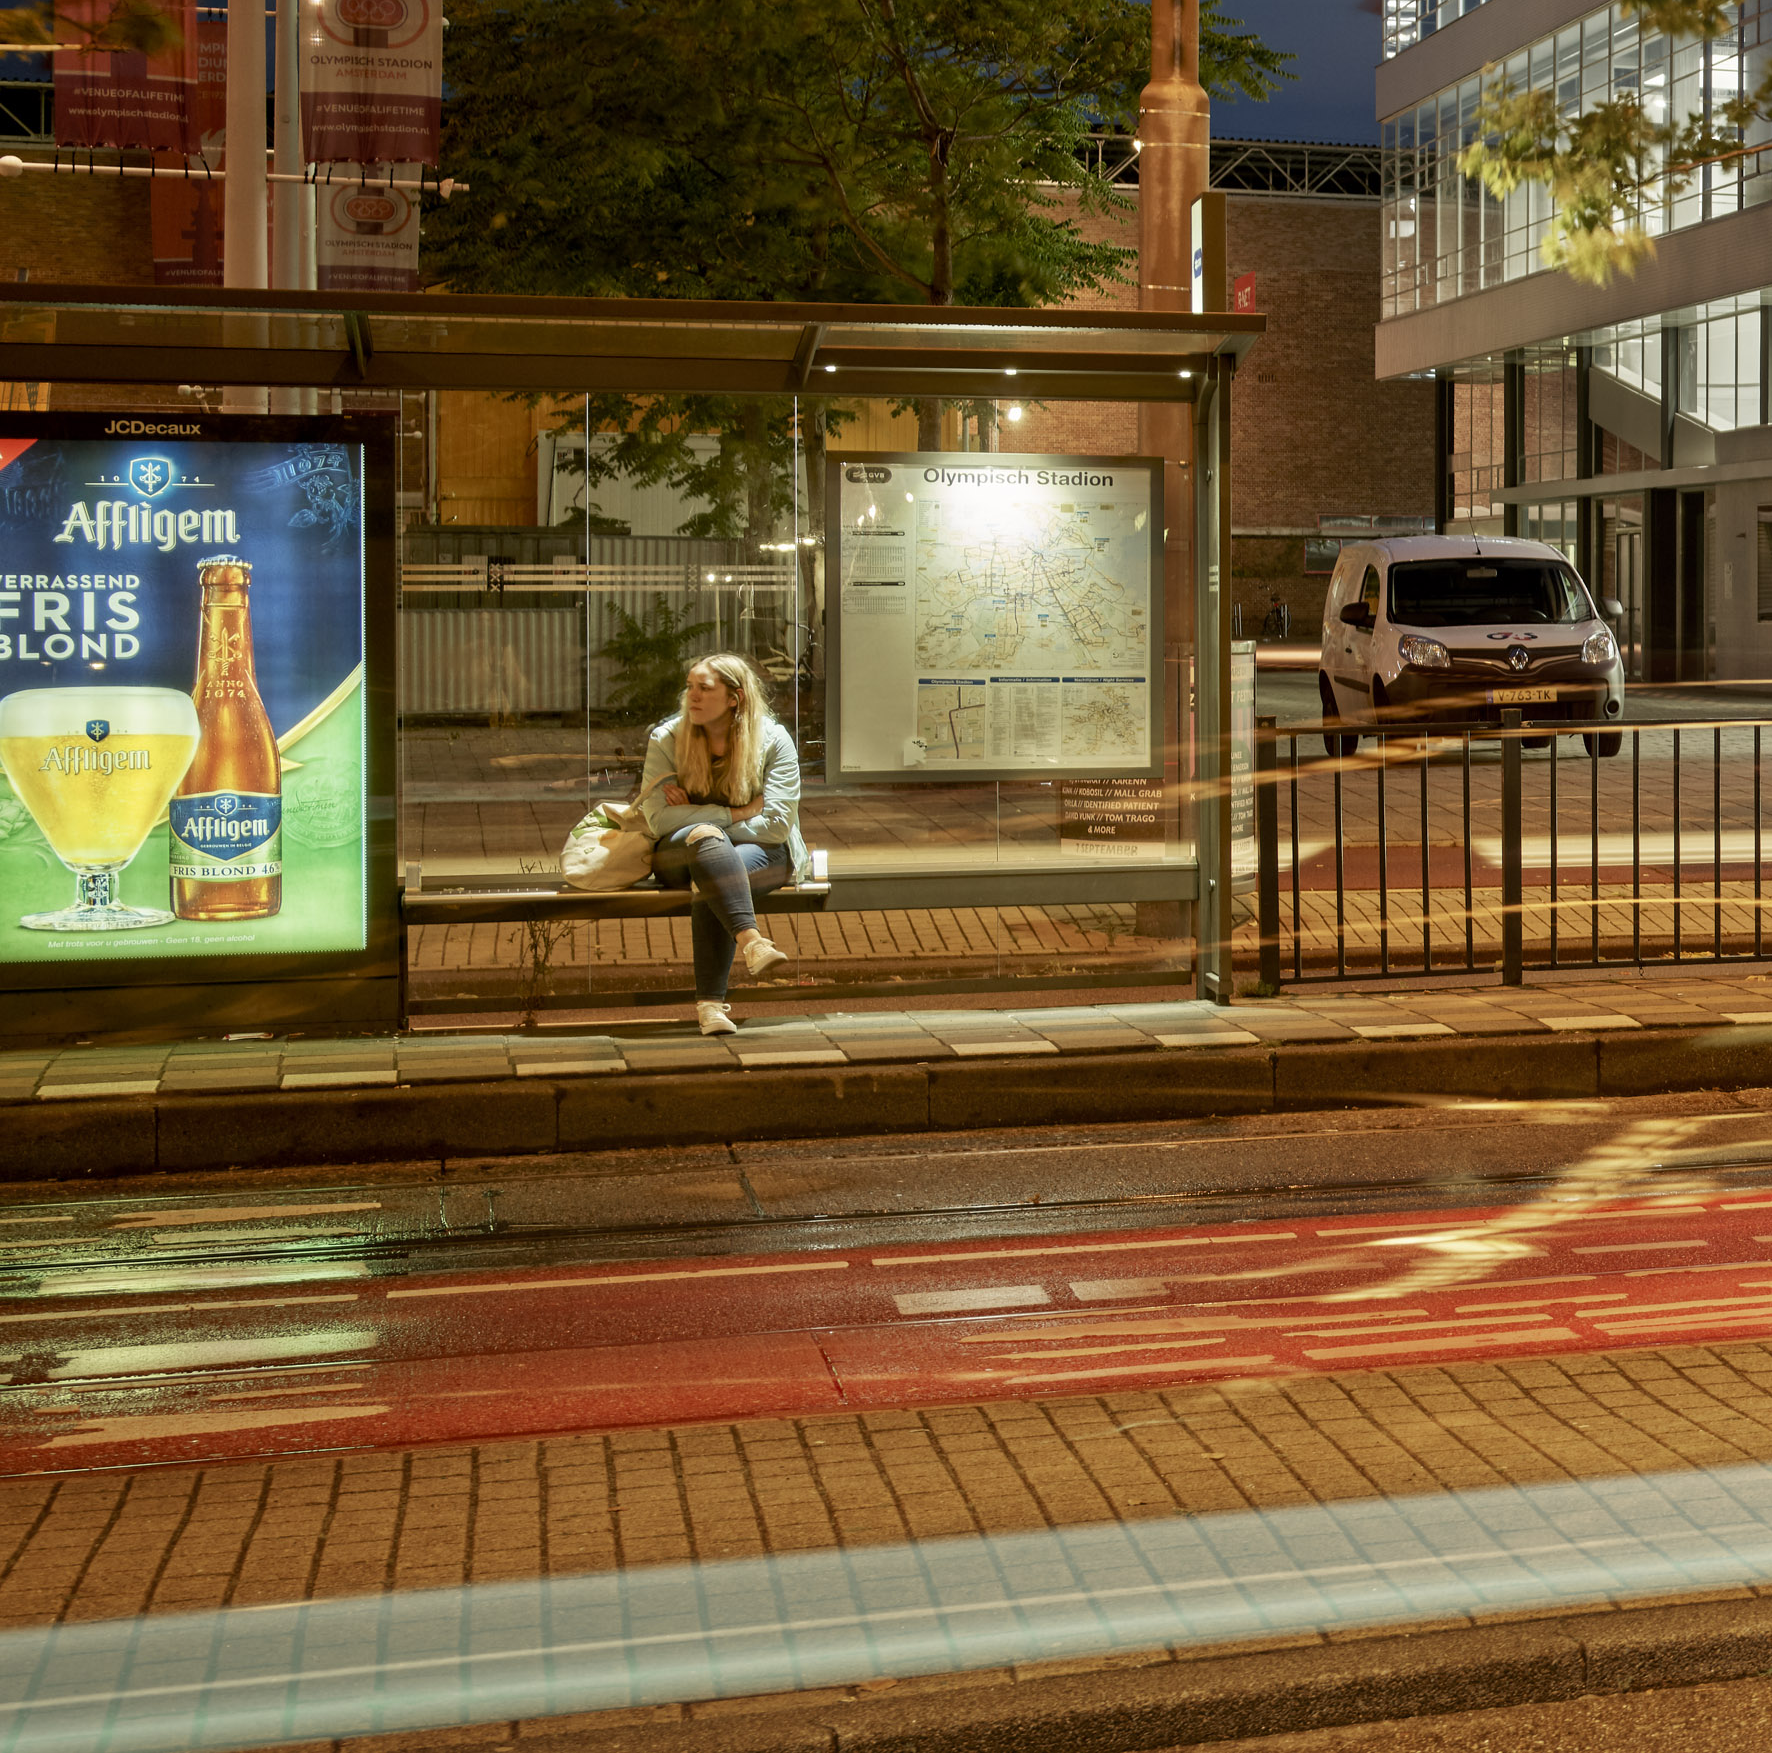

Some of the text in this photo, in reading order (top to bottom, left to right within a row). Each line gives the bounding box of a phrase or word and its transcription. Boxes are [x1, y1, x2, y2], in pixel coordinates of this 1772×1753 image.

[310, 55, 433, 69] OLYMPISCH STADION
[336, 68, 407, 80] AMSTERDAM
[105, 420, 201, 435] JCDecaux
[923, 468, 1114, 487] Olympisch Stadion
[54, 501, 241, 551] Affligem
[0, 574, 140, 590] ERRASSEND
[0, 591, 140, 632] FRIS
[0, 633, 140, 660] BLOND
[206, 680, 244, 689] ANNO
[205, 689, 247, 699] 1074
[1498, 690, 1551, 702] V-763-TK
[38, 746, 151, 776] Affligem
[1079, 787, 1103, 796] KOBOSIL
[1114, 789, 1136, 798] MALL
[1138, 790, 1162, 798] GRAB
[1083, 801, 1121, 809] IDENTIFIED
[1123, 802, 1159, 810] PATIENT
[1105, 814, 1123, 822] TOM
[1126, 814, 1155, 823] TRAGO
[181, 815, 270, 844] Affligem
[1087, 825, 1116, 834] & MORE
[1080, 843, 1138, 856] SEPTEMBER
[174, 865, 197, 876] FRIS
[202, 866, 257, 877] BLOND
[48, 940, 64, 949] Met
[65, 939, 84, 948] trots
[85, 940, 104, 948] voor
[113, 937, 158, 947] gebrouwen
[165, 936, 189, 945] Geen
[204, 935, 224, 947] geen
[226, 933, 256, 944] alcohol
